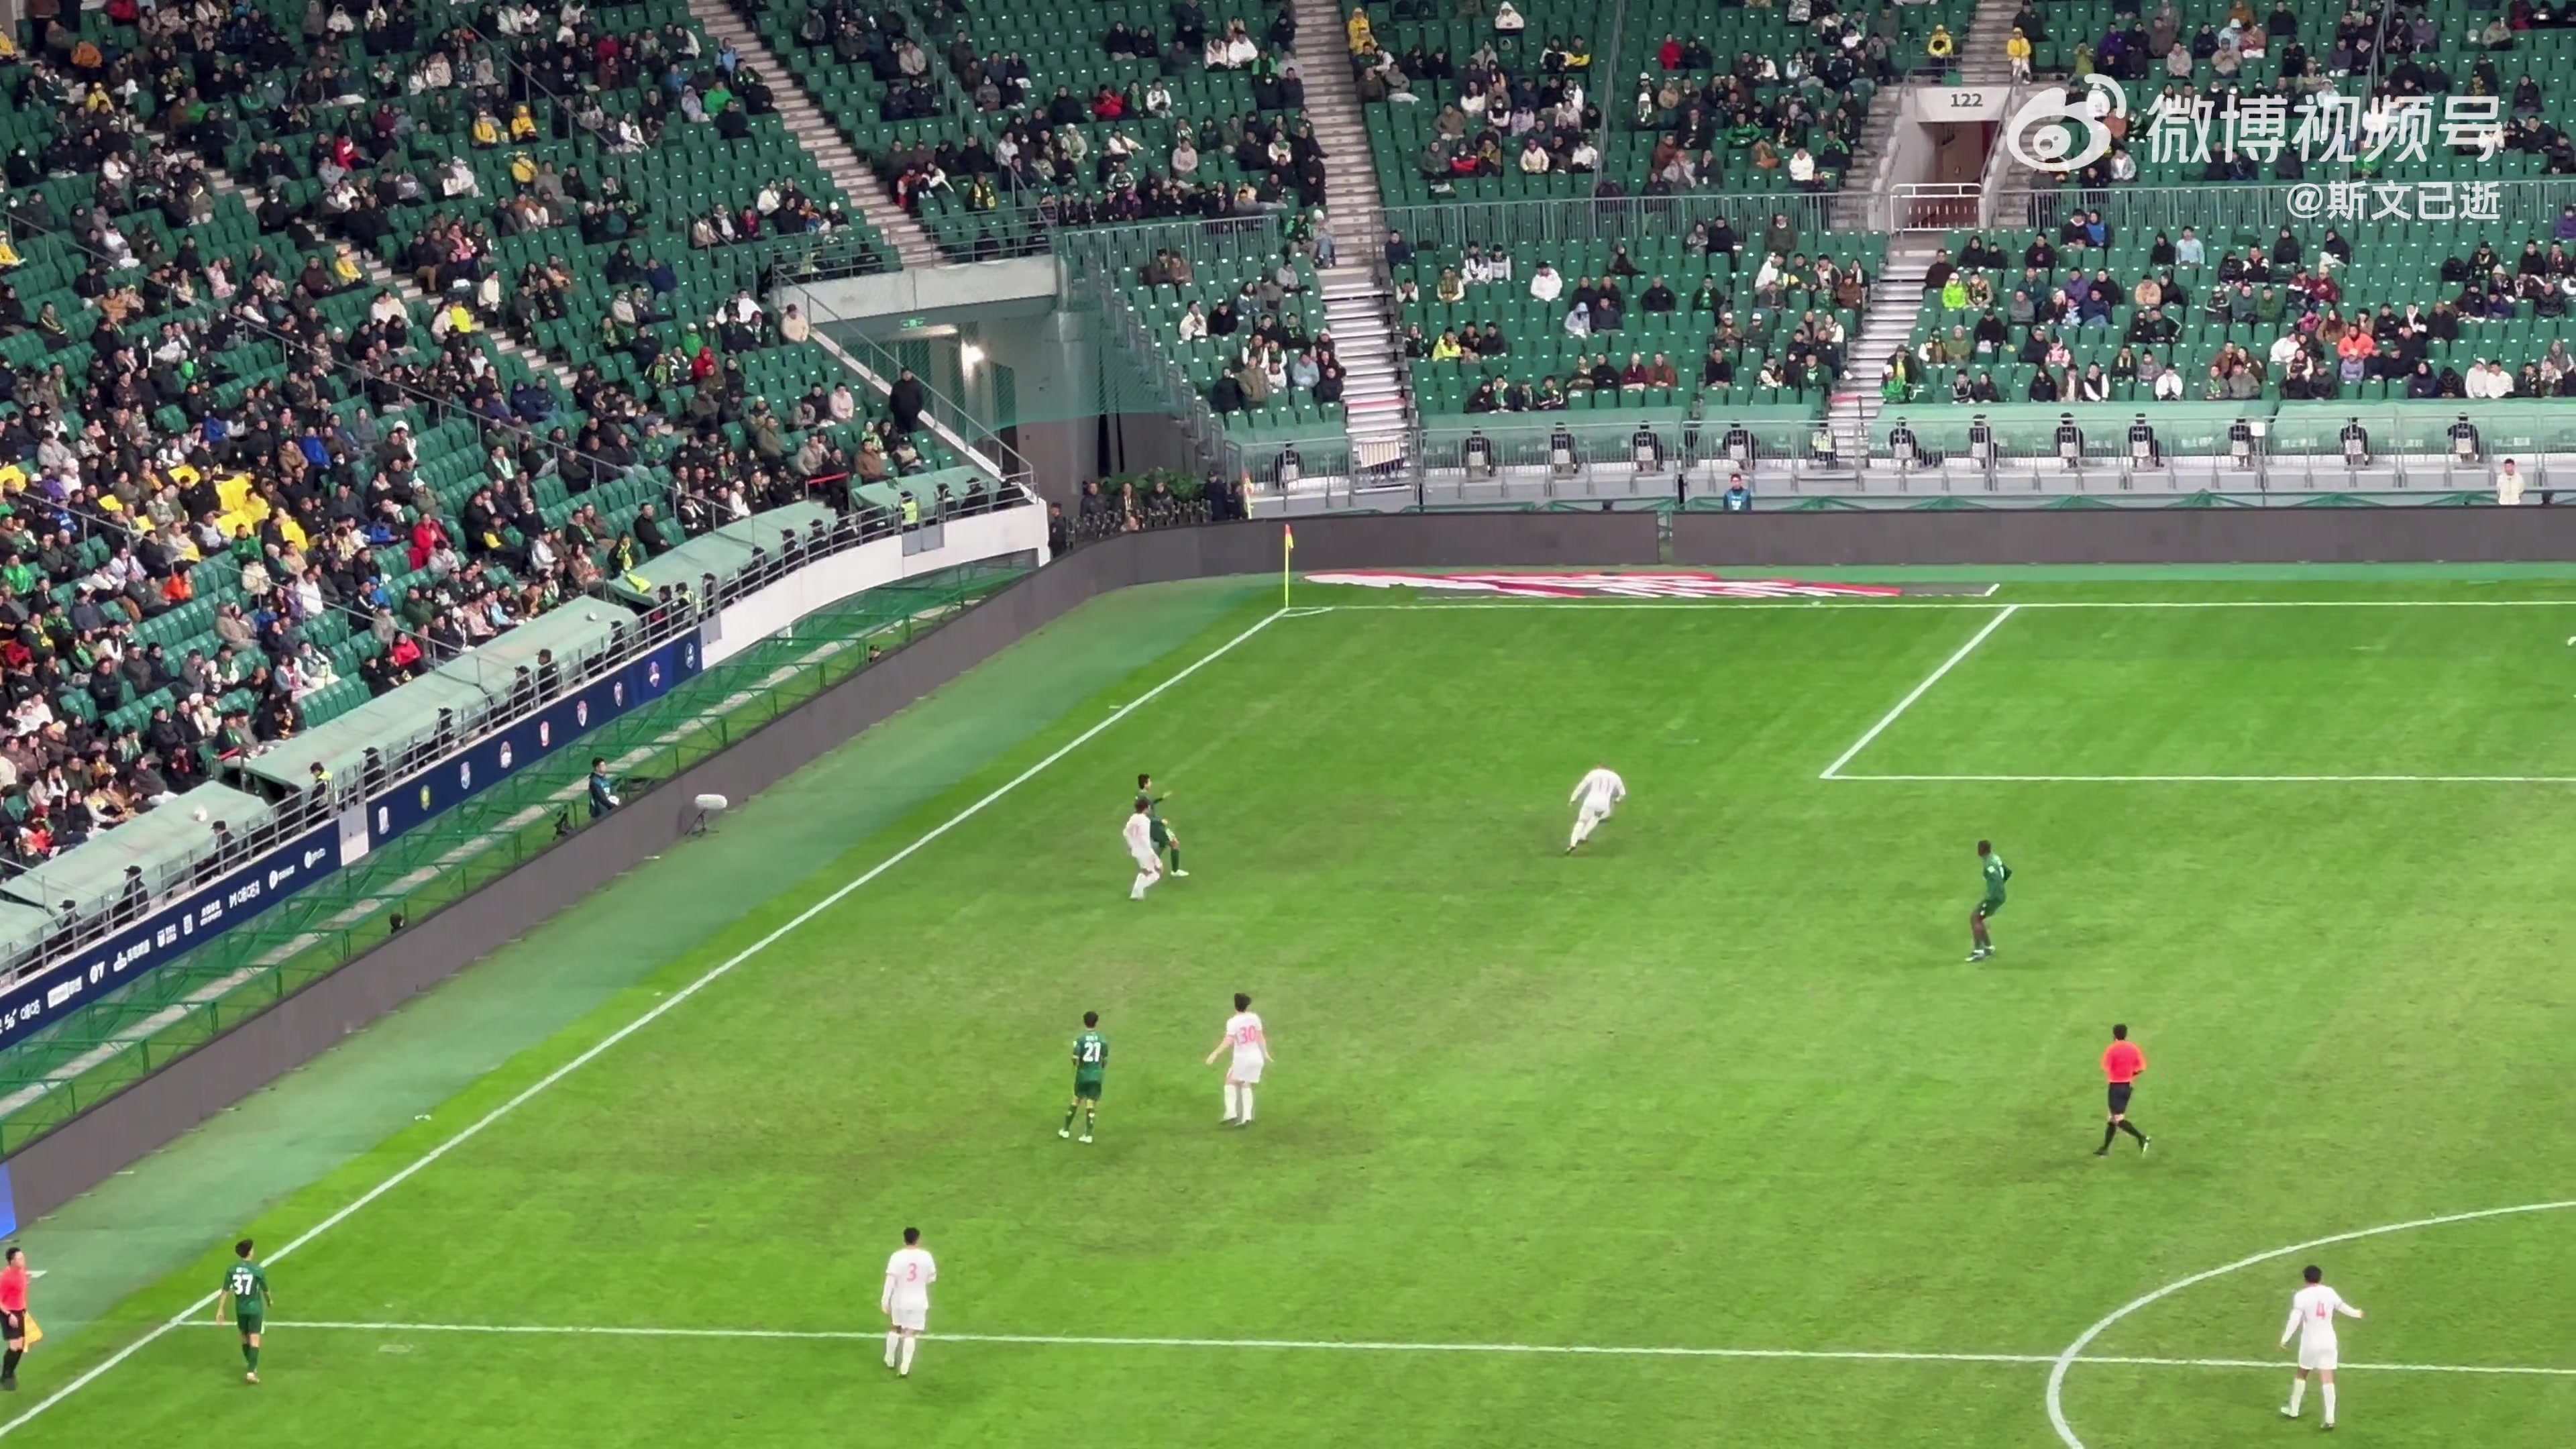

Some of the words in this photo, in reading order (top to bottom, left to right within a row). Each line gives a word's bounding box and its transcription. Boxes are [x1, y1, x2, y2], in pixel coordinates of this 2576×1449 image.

[1951, 93, 1983, 107] 122
[1239, 1025, 1256, 1044] 30
[1083, 1041, 1101, 1062] 21
[906, 1263, 917, 1282] 3
[232, 1274, 254, 1295] 37
[2316, 1300, 2326, 1320] 4
